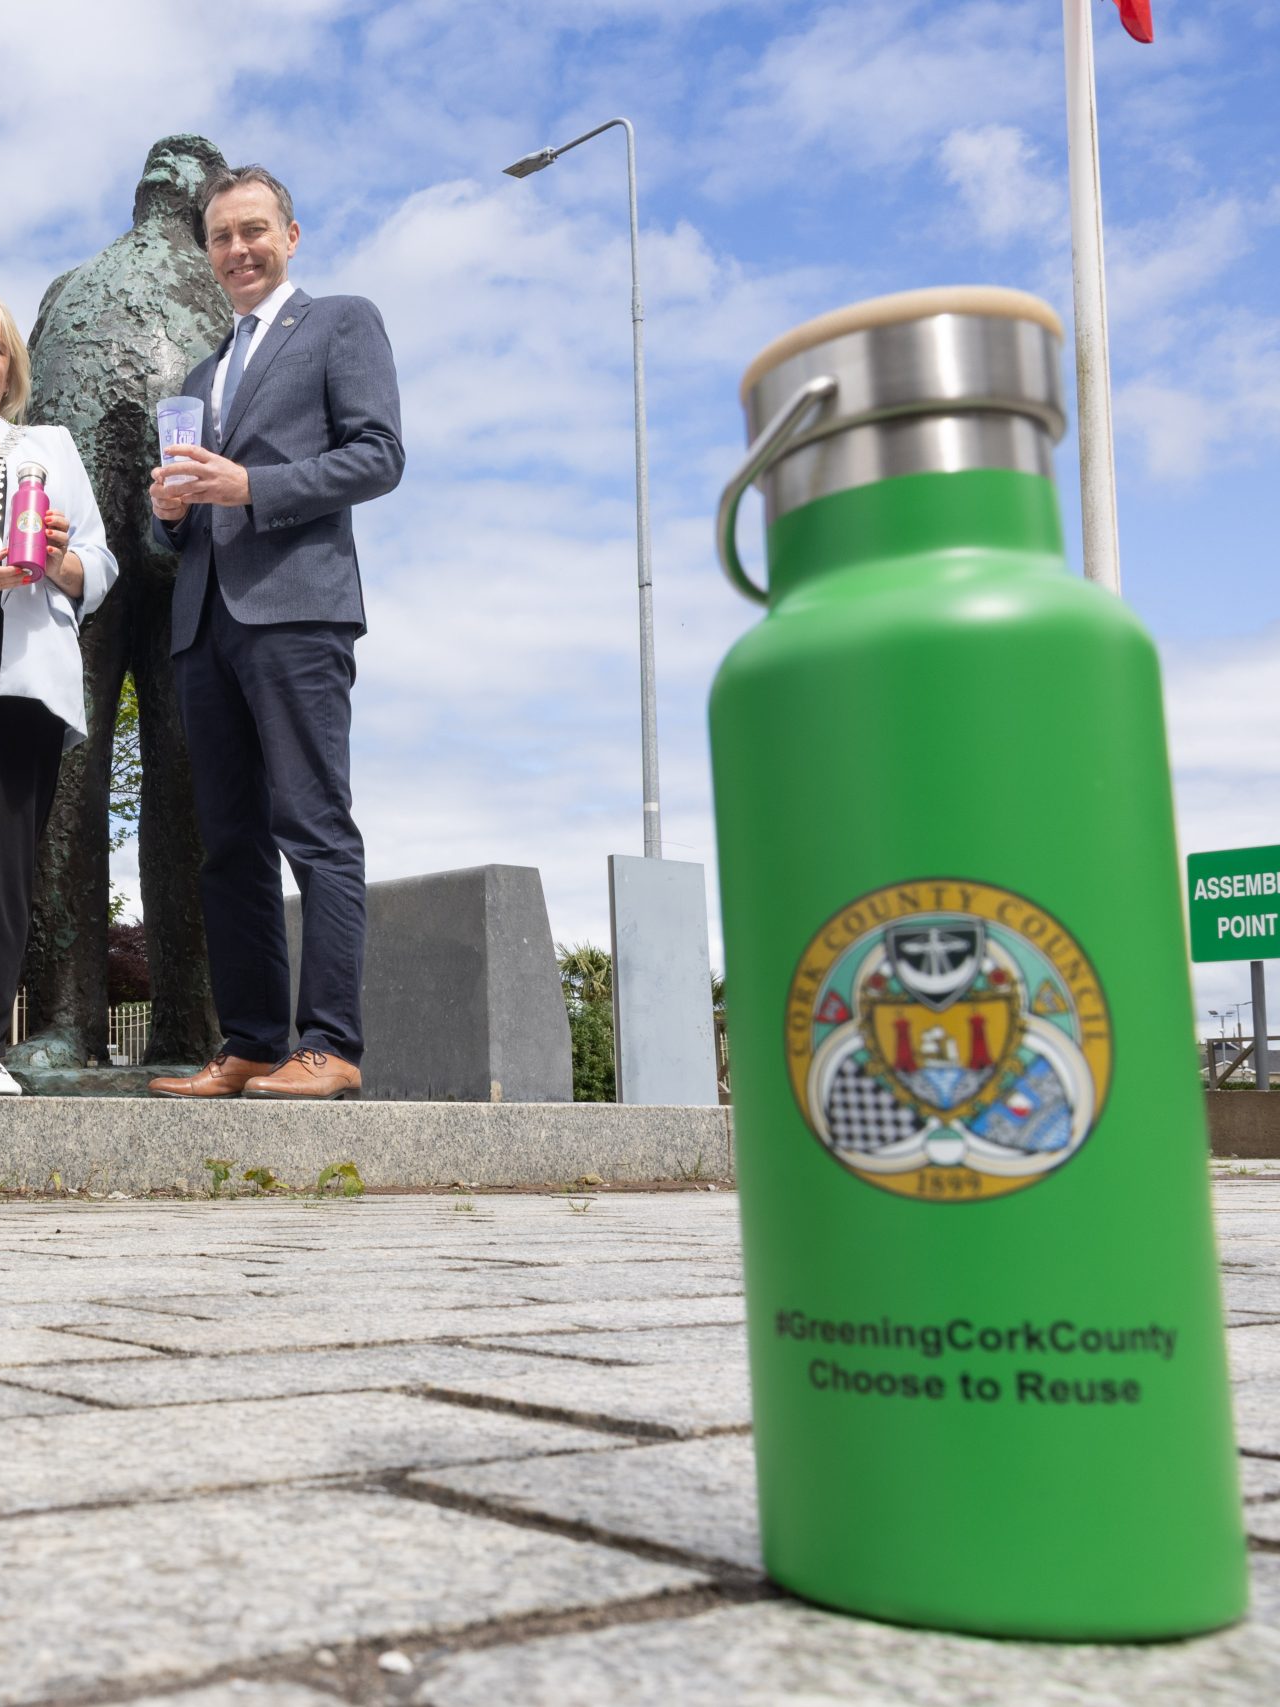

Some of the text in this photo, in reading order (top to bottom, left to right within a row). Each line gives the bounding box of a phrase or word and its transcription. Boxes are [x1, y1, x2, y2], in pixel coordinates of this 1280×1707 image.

[1194, 872, 1280, 900] ASSEMB
[1217, 913, 1278, 939] POINT
[790, 886, 1105, 1057] CORK COUNTY COUNCIL
[918, 1169, 982, 1194] 1899
[774, 1308, 1178, 1361] #GreeningCorkCounty
[808, 1357, 1142, 1405] Choose to Reuse
